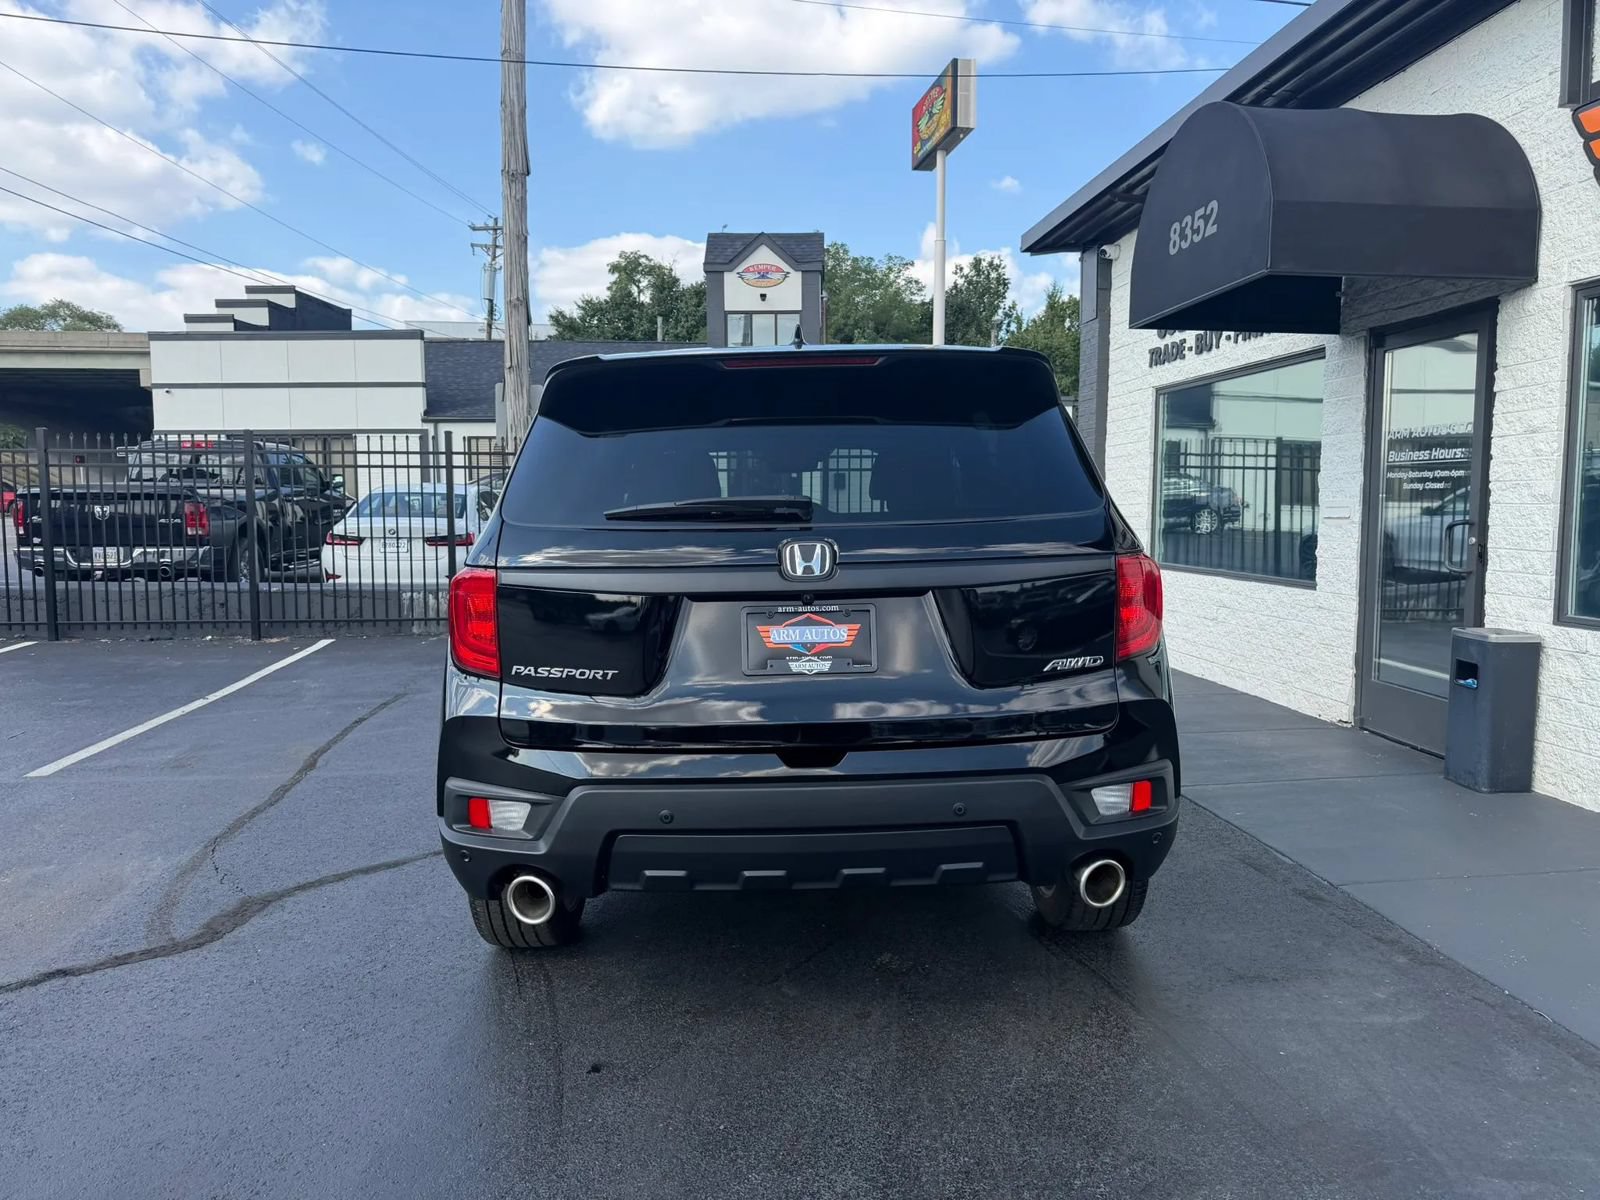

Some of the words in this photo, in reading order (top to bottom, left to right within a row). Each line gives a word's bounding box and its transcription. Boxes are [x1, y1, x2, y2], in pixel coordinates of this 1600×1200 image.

[1169, 199, 1219, 256] 8352
[1148, 338, 1187, 368] TRADE
[1194, 331, 1223, 356] BUY
[1388, 449, 1431, 462] Business
[1431, 447, 1465, 460] Hours:
[777, 605, 840, 613] arm-autos.com
[770, 628, 800, 641] ARM
[803, 627, 849, 641] AUTOS
[1042, 655, 1104, 672] AWD
[511, 665, 620, 680] PASSPORT
